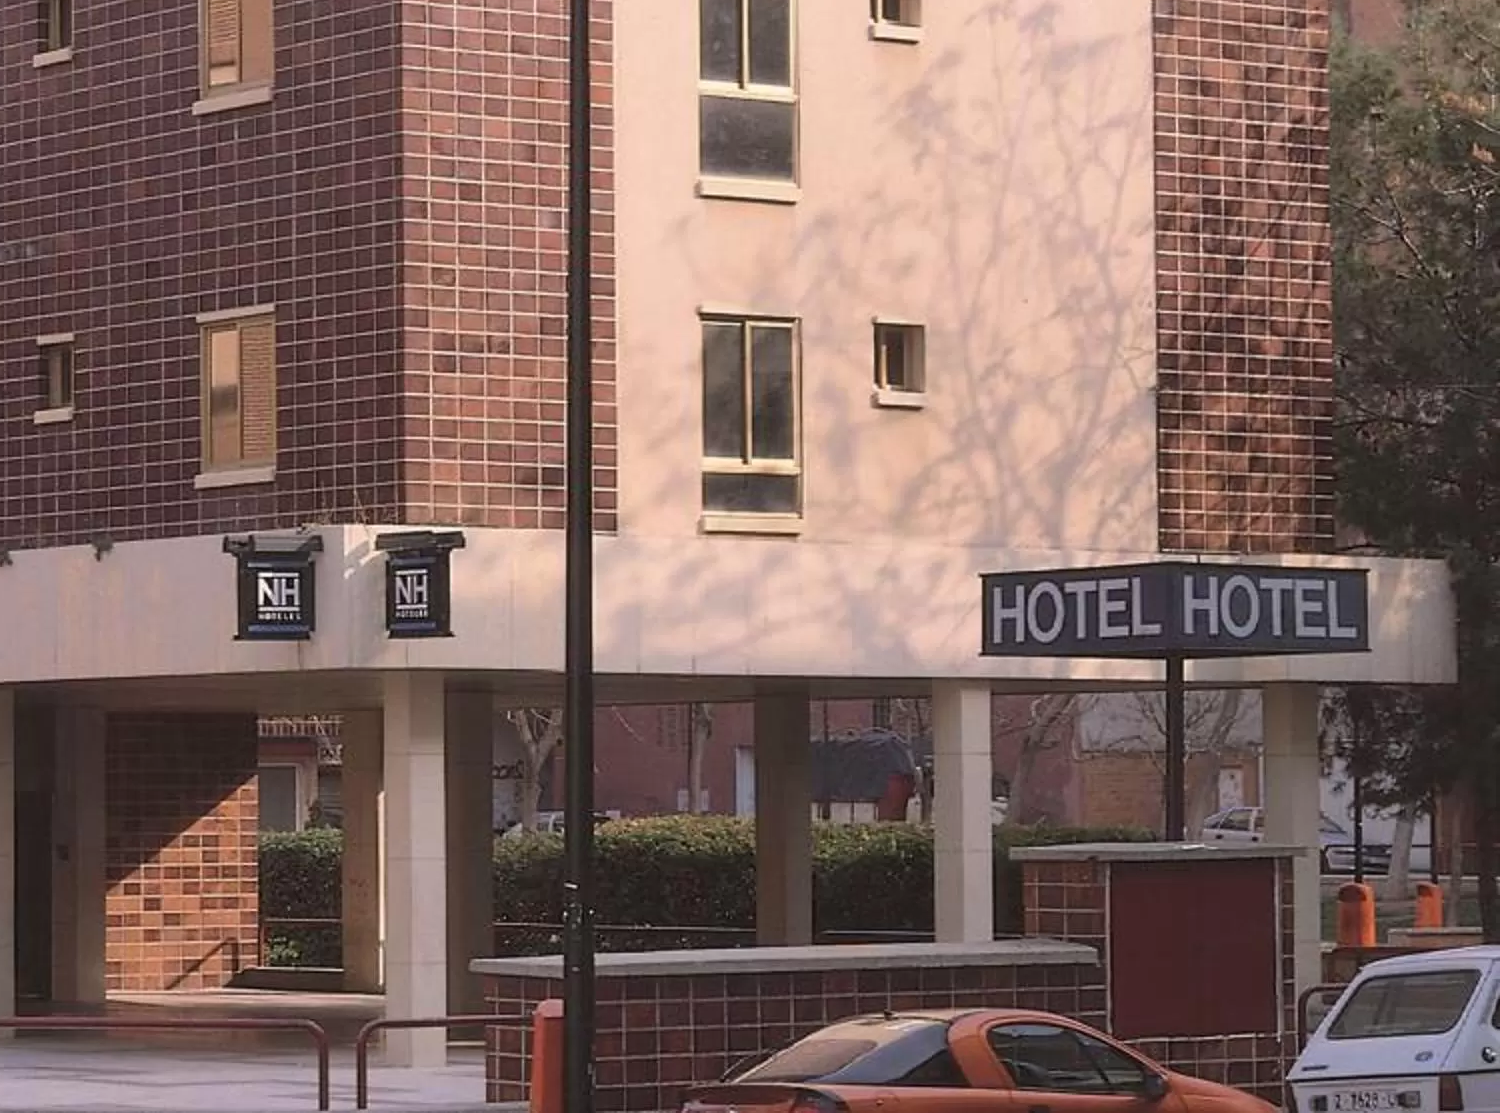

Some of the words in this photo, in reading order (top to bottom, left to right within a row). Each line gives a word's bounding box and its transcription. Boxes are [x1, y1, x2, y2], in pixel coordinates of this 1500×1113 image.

[257, 578, 300, 606] NH
[395, 574, 428, 604] NH
[993, 576, 1162, 644] HOTEL
[1183, 574, 1358, 639] HOTEL
